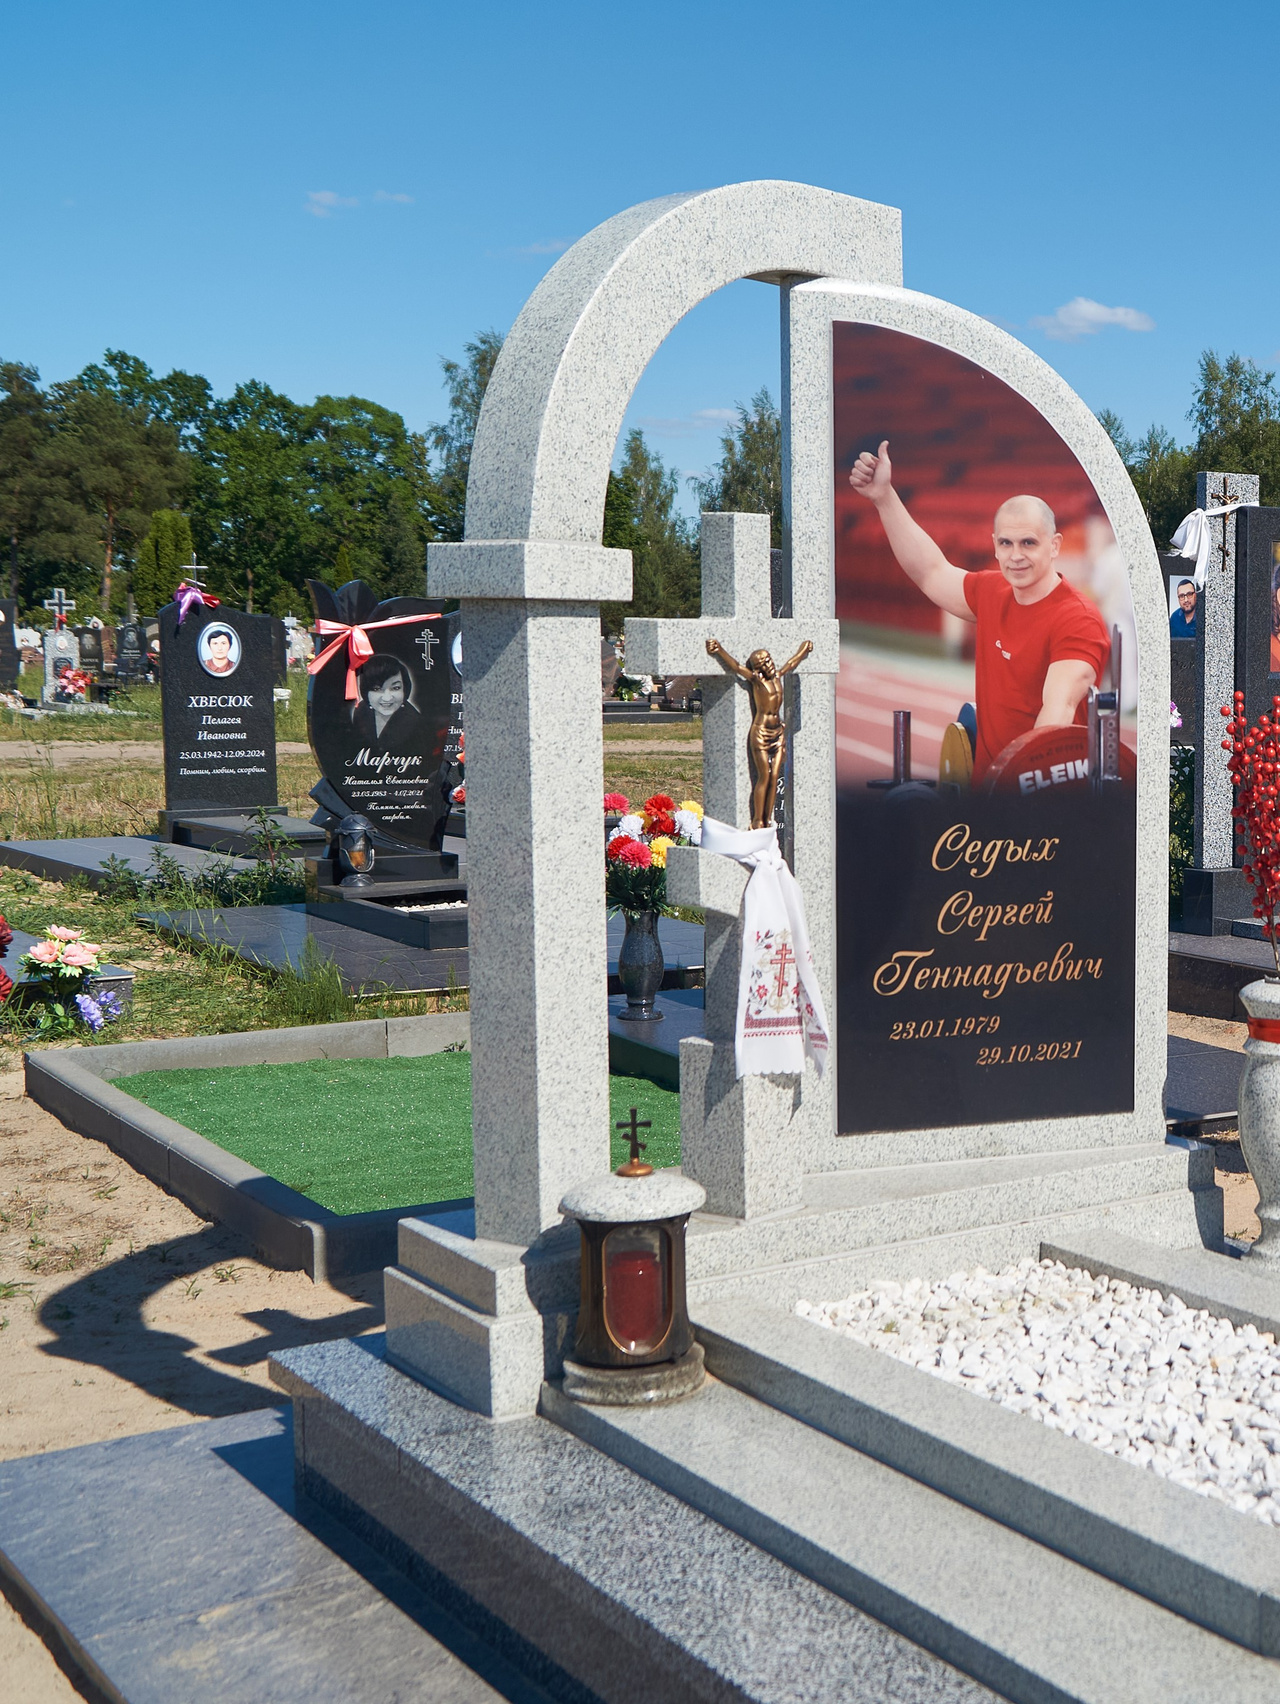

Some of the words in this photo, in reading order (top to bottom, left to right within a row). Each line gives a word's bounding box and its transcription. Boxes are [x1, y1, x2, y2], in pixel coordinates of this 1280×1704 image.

[187, 695, 254, 708] ХВЕСЮК
[201, 715, 242, 725] Пелагея
[197, 730, 247, 741] Ивановна
[179, 749, 266, 760] 25.03.1942-12.09.2024
[344, 747, 423, 774] Марчук
[179, 768, 211, 776] Помним,
[342, 775, 384, 787] Наталья
[385, 774, 429, 786] Евгеньевна
[931, 823, 1060, 878] Седых
[937, 890, 1054, 942] Сергей
[873, 942, 1103, 999] Геннадьевич
[888, 1015, 1001, 1041] 23.01.1979
[975, 1040, 1083, 1066] 29.10.2021
